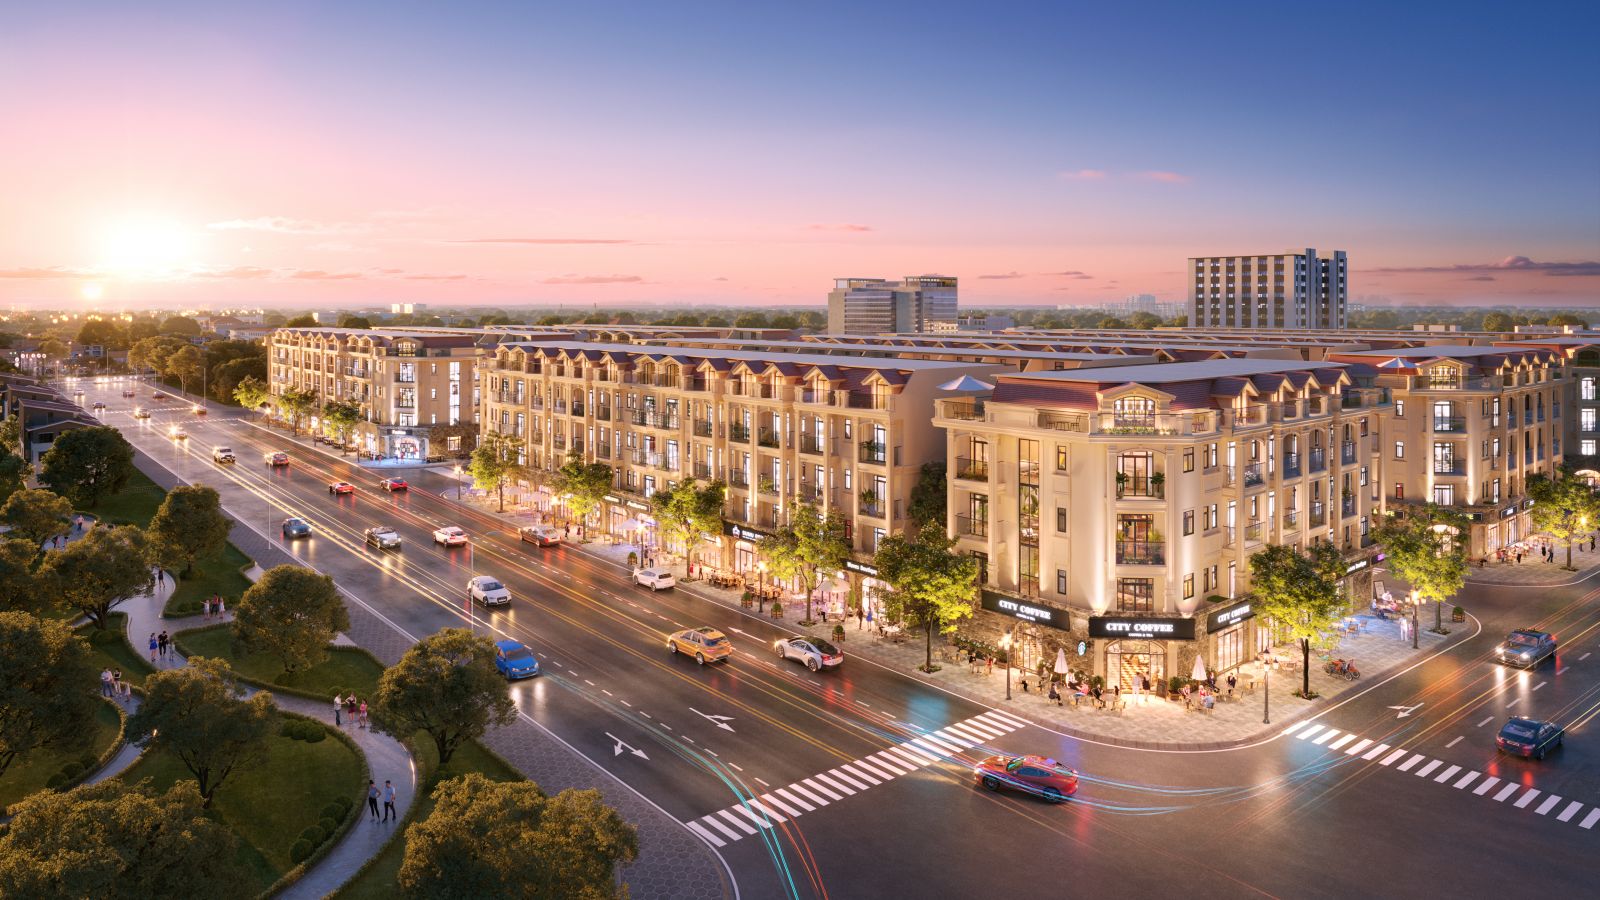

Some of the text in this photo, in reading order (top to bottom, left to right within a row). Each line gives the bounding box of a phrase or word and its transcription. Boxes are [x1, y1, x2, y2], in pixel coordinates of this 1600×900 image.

[998, 600, 1018, 611] CITY
[1019, 605, 1051, 620] COFFEE
[1217, 611, 1231, 623] CITY
[1105, 622, 1174, 632] CITY COFFEE
